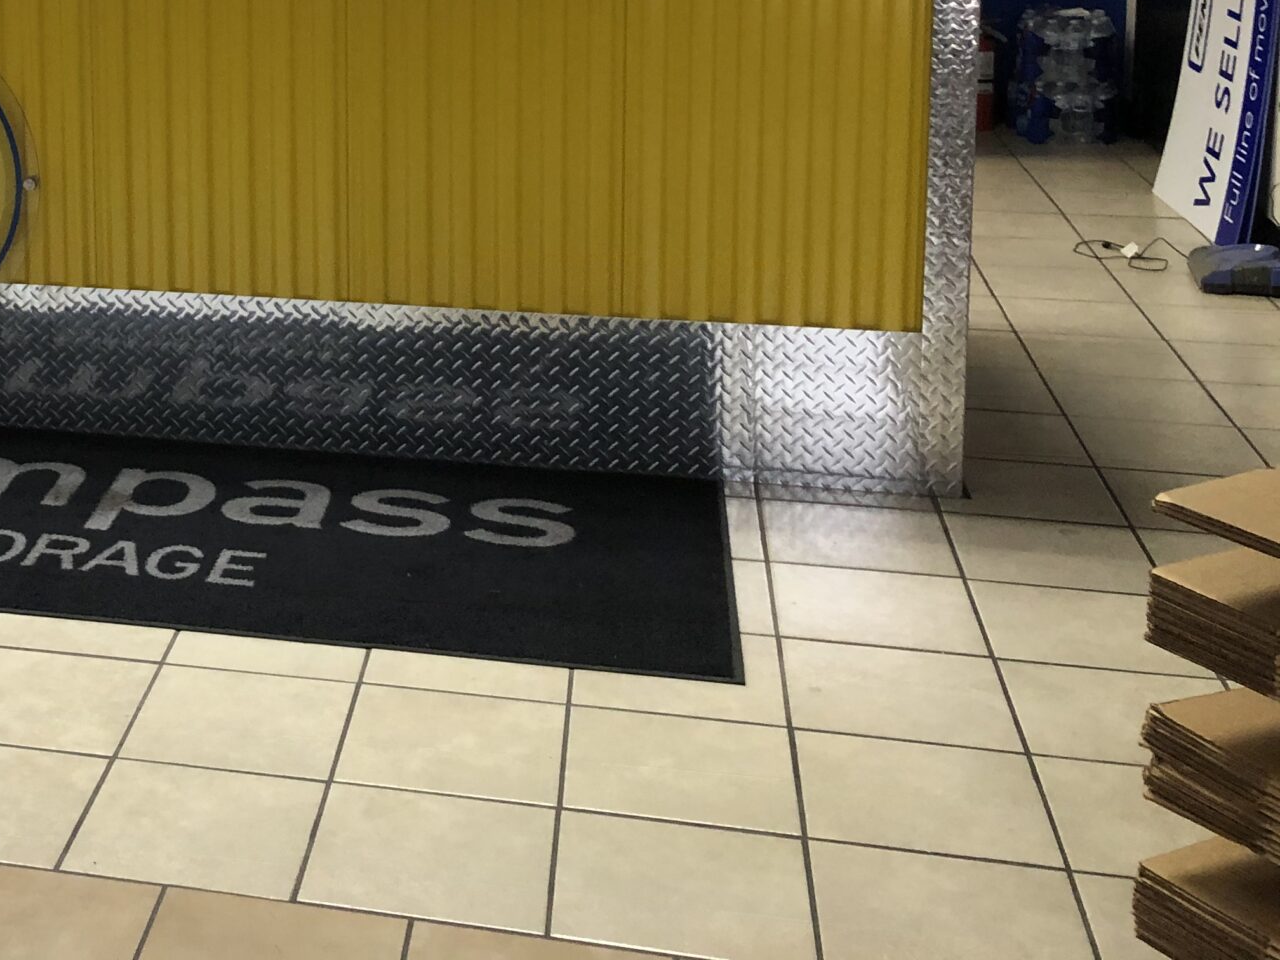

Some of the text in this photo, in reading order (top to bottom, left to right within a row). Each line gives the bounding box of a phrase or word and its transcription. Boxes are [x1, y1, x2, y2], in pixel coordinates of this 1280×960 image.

[1193, 127, 1225, 206] WE
[1223, 171, 1244, 224] Full
[1235, 111, 1254, 164] line
[1248, 67, 1261, 102] of
